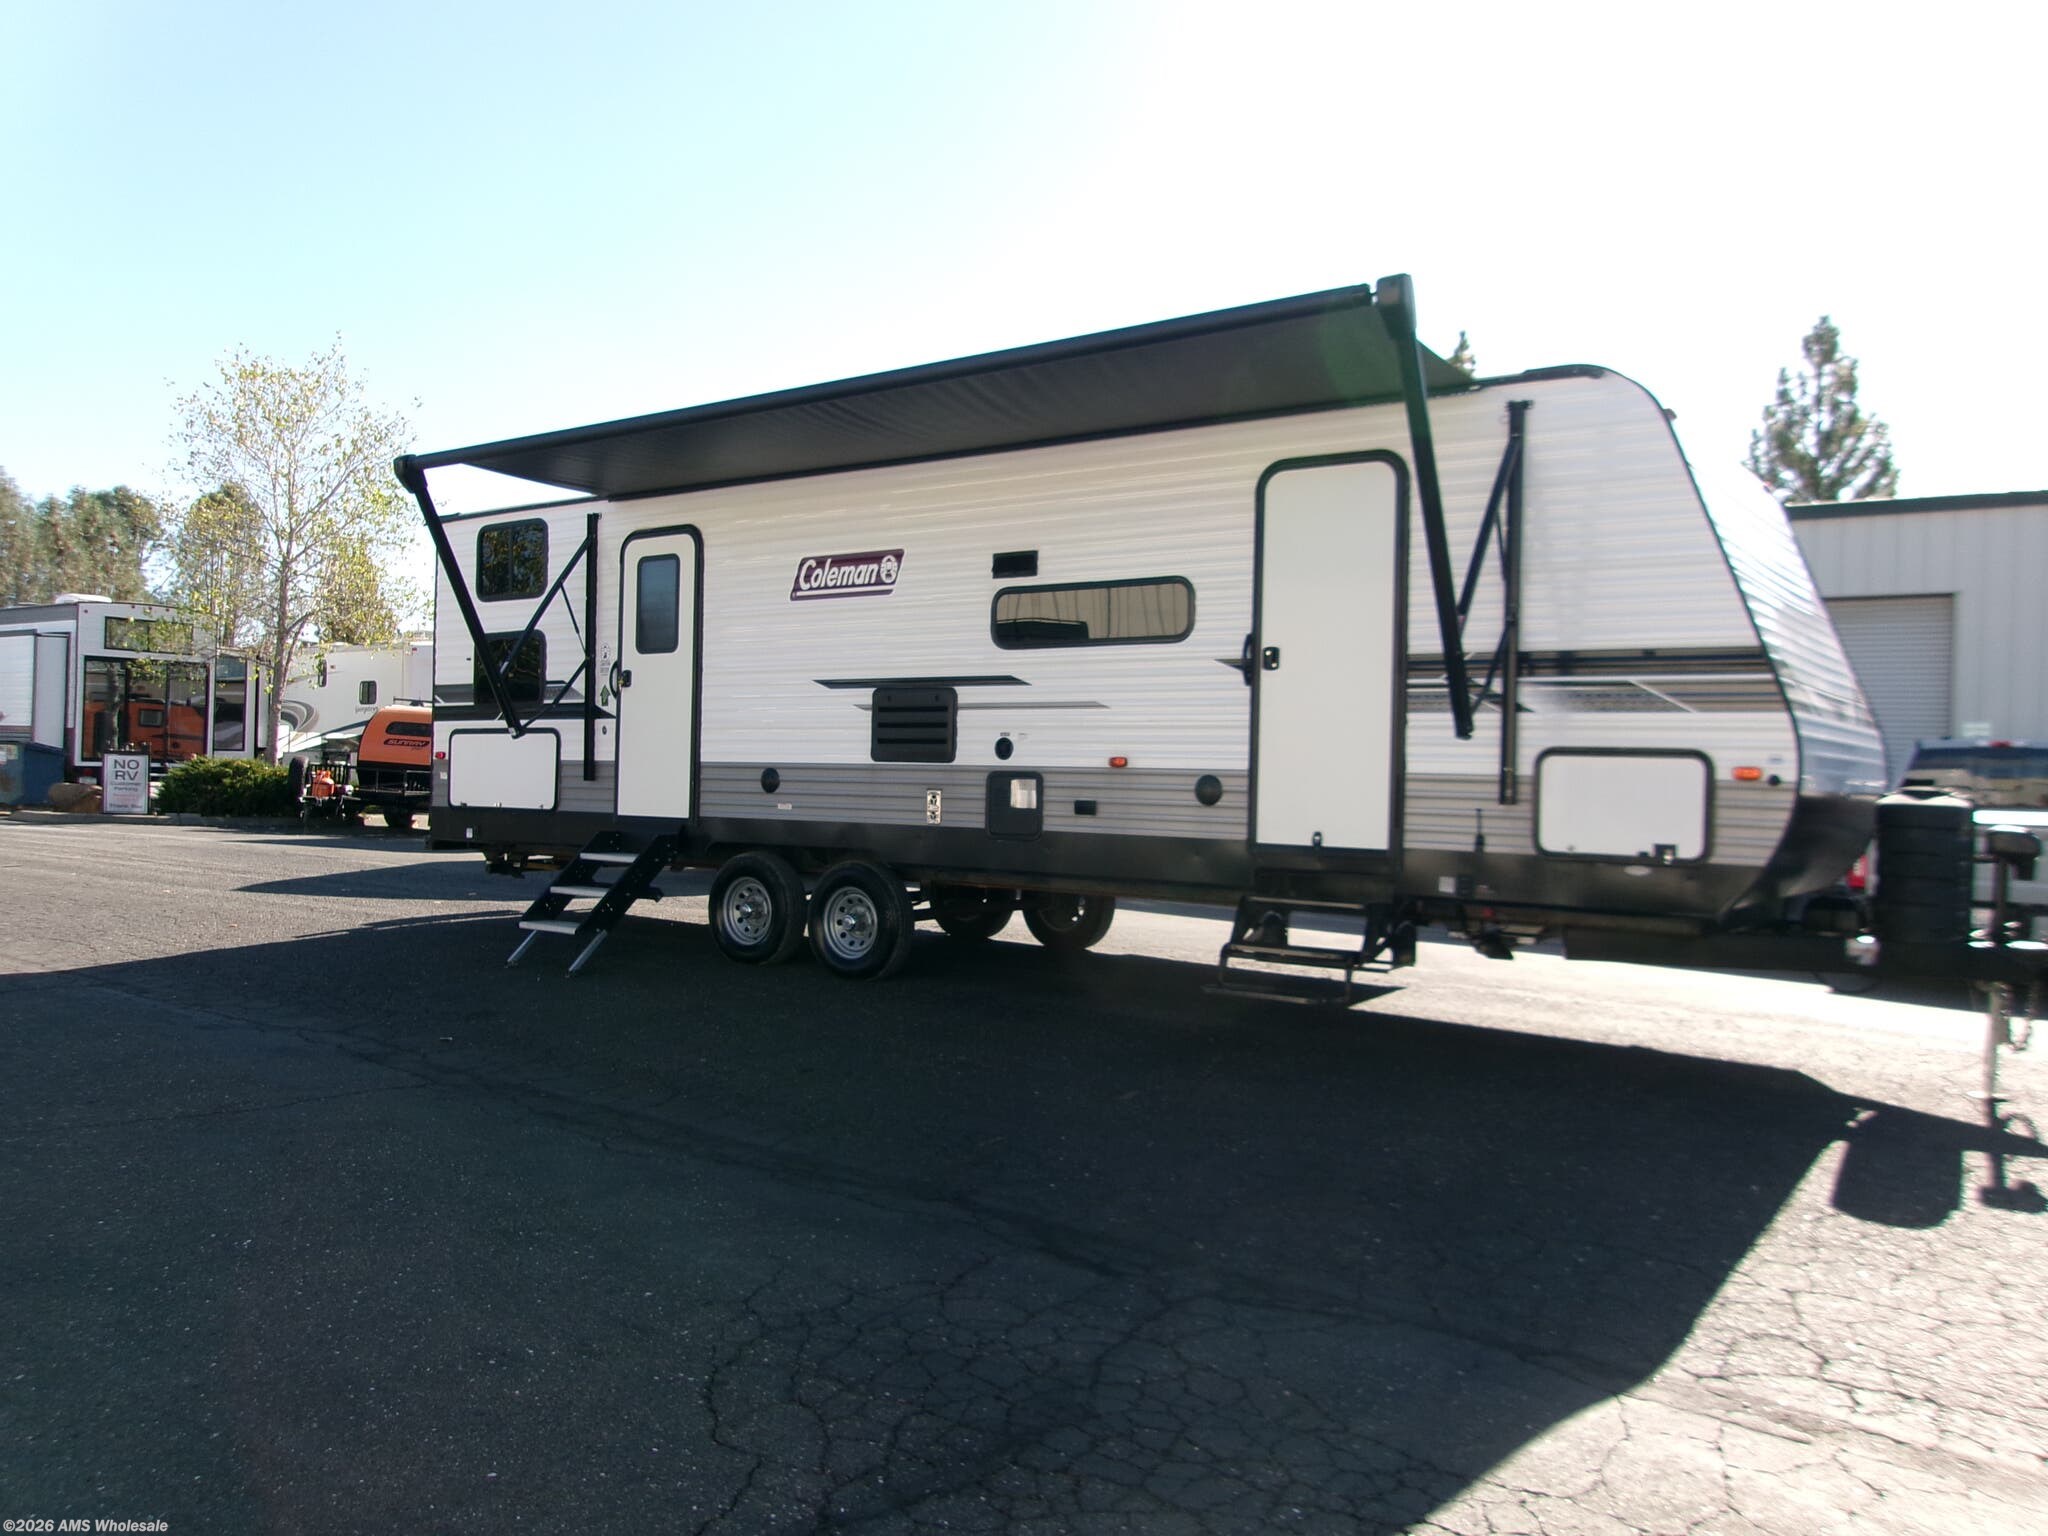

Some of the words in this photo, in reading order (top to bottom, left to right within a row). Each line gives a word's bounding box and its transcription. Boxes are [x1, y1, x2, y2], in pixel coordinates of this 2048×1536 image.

[799, 558, 878, 590] Coleman
[114, 759, 140, 770] NO
[114, 770, 139, 781] RV
